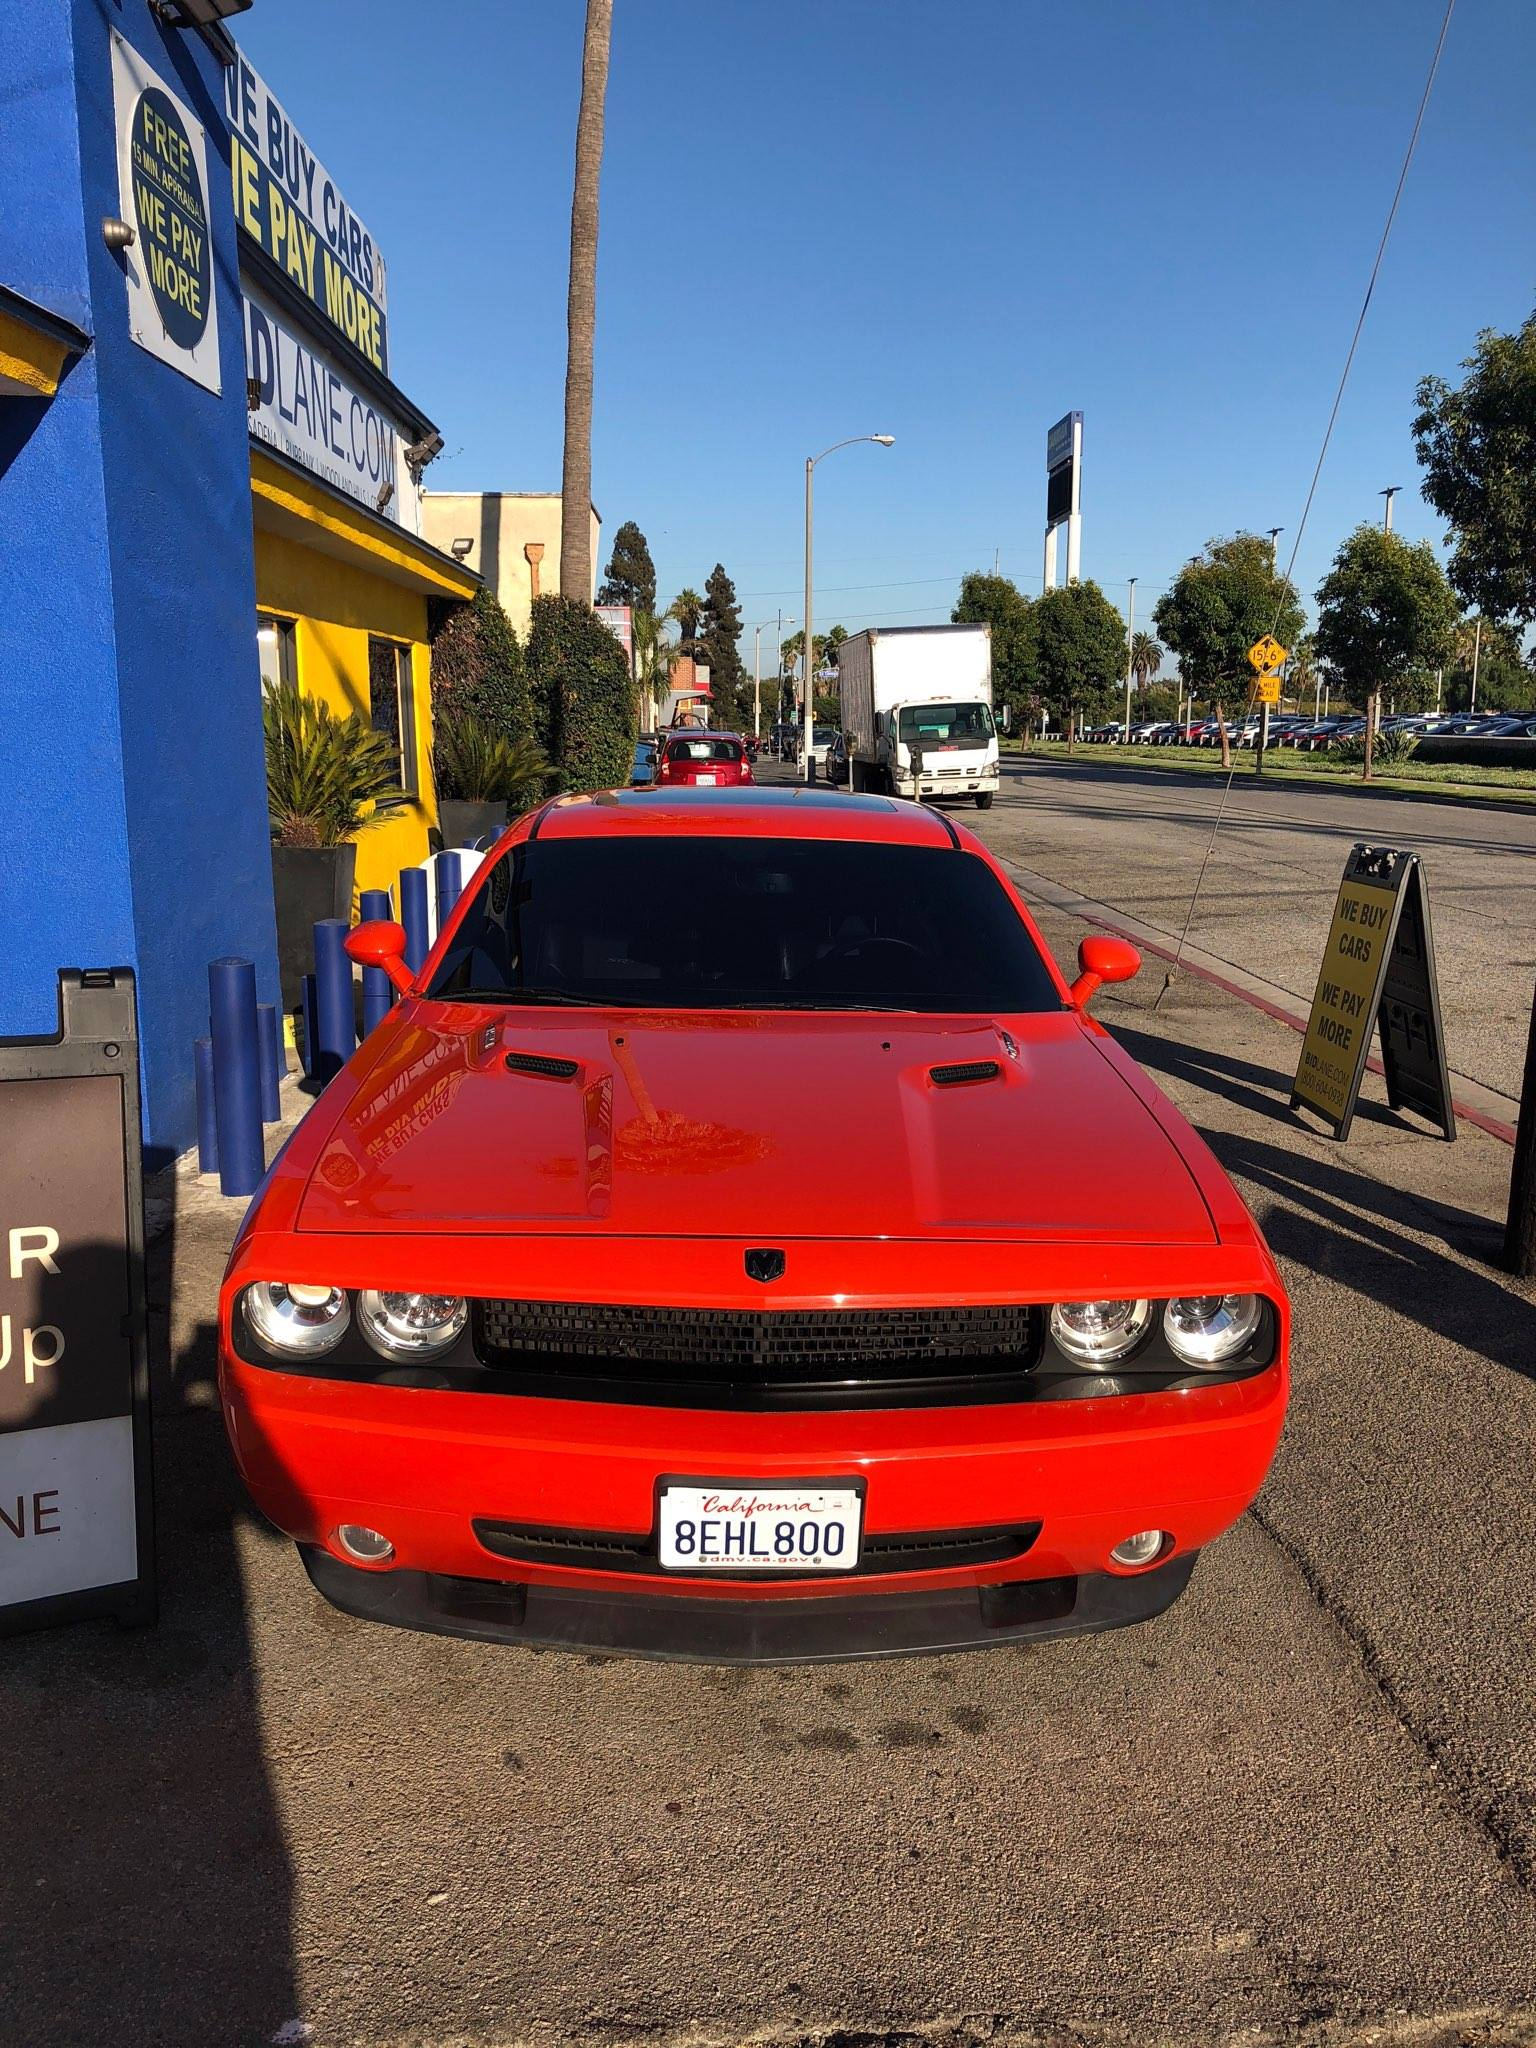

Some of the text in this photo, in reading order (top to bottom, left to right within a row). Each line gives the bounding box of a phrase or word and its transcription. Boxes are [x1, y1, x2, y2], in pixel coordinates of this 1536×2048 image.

[143, 101, 190, 184] FREE
[132, 141, 205, 224] 15 MIN. APPRAISAL
[266, 94, 317, 220] BUY
[323, 180, 374, 293] CARS
[136, 179, 201, 273] WE PAY
[149, 242, 202, 320] MORE
[269, 180, 316, 300] PAY
[323, 248, 383, 372] MORE
[1341, 898, 1388, 930] WE BUY
[1339, 933, 1372, 962] CARS
[1322, 981, 1365, 1017] WE PAY
[1317, 1015, 1352, 1050] MORE
[1305, 1051, 1349, 1088] BIDLANE.COM
[703, 1495, 825, 1519] California
[675, 1520, 845, 1556] 8EHL800
